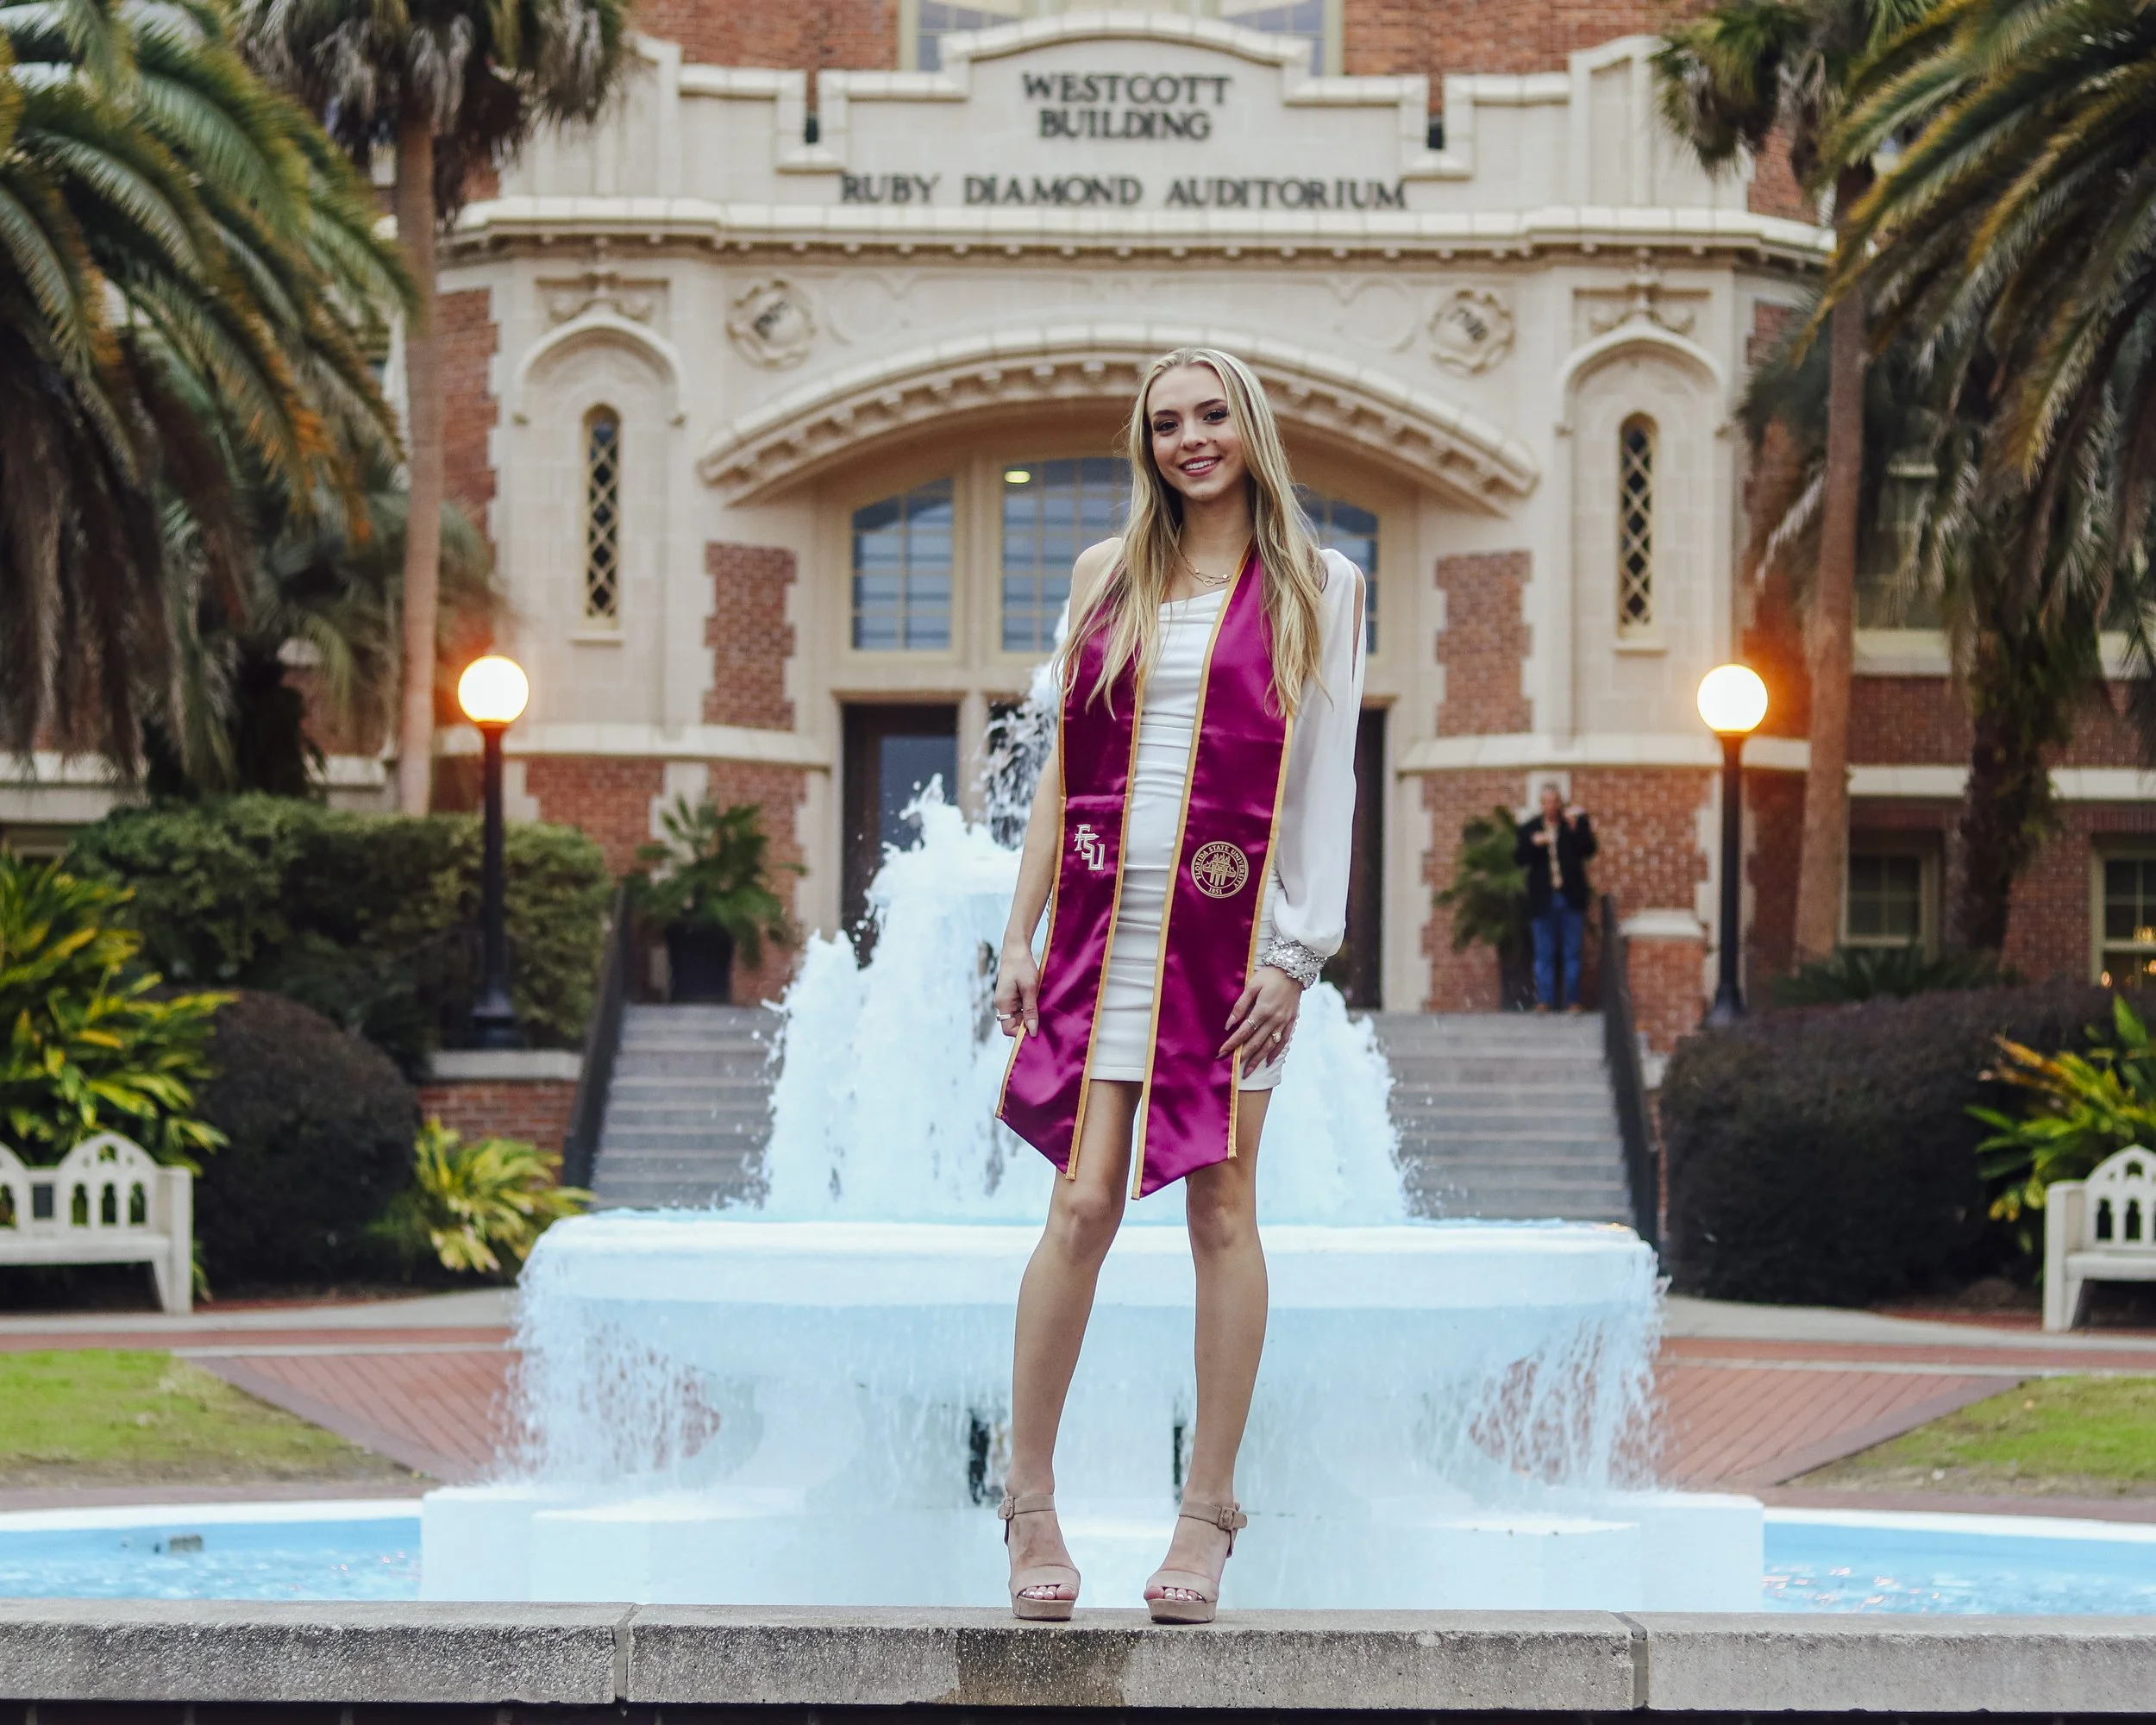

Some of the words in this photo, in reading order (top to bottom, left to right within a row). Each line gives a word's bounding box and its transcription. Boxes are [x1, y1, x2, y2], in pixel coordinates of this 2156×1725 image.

[1022, 72, 1232, 104] WESTCOTT
[1039, 110, 1211, 140] BUILDING
[843, 175, 938, 204] RUBY
[964, 176, 1143, 207] DIAMOND
[1165, 178, 1407, 209] AUDITORIUM
[1074, 824, 1105, 871] FSU
[1194, 850, 1208, 881] FLORIDA
[1230, 849, 1245, 888] UNIVERSITY
